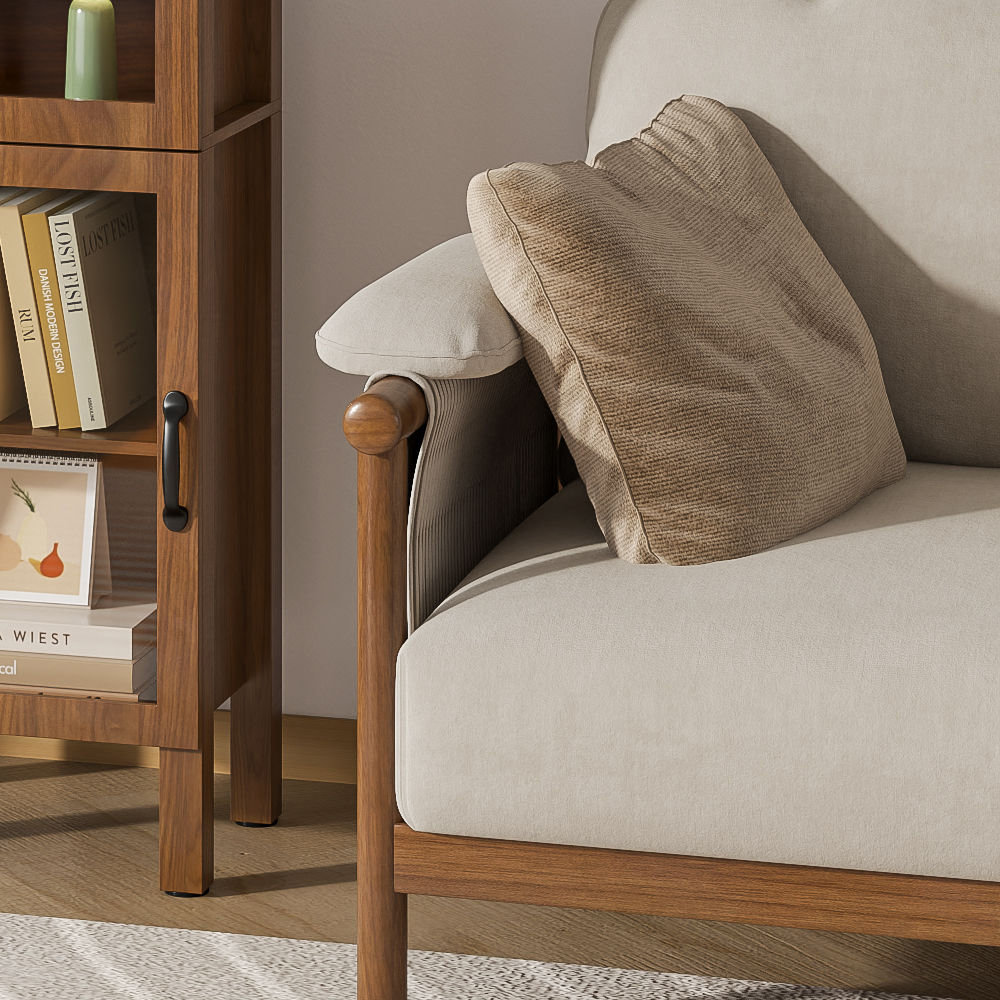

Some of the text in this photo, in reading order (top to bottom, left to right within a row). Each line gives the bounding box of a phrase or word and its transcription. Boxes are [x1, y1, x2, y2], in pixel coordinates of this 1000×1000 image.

[54, 220, 84, 313] LOST FISH
[18, 308, 36, 342] RUM
[38, 268, 65, 374] DANISH MODERN DESIGN
[13, 629, 71, 646] WIEST
